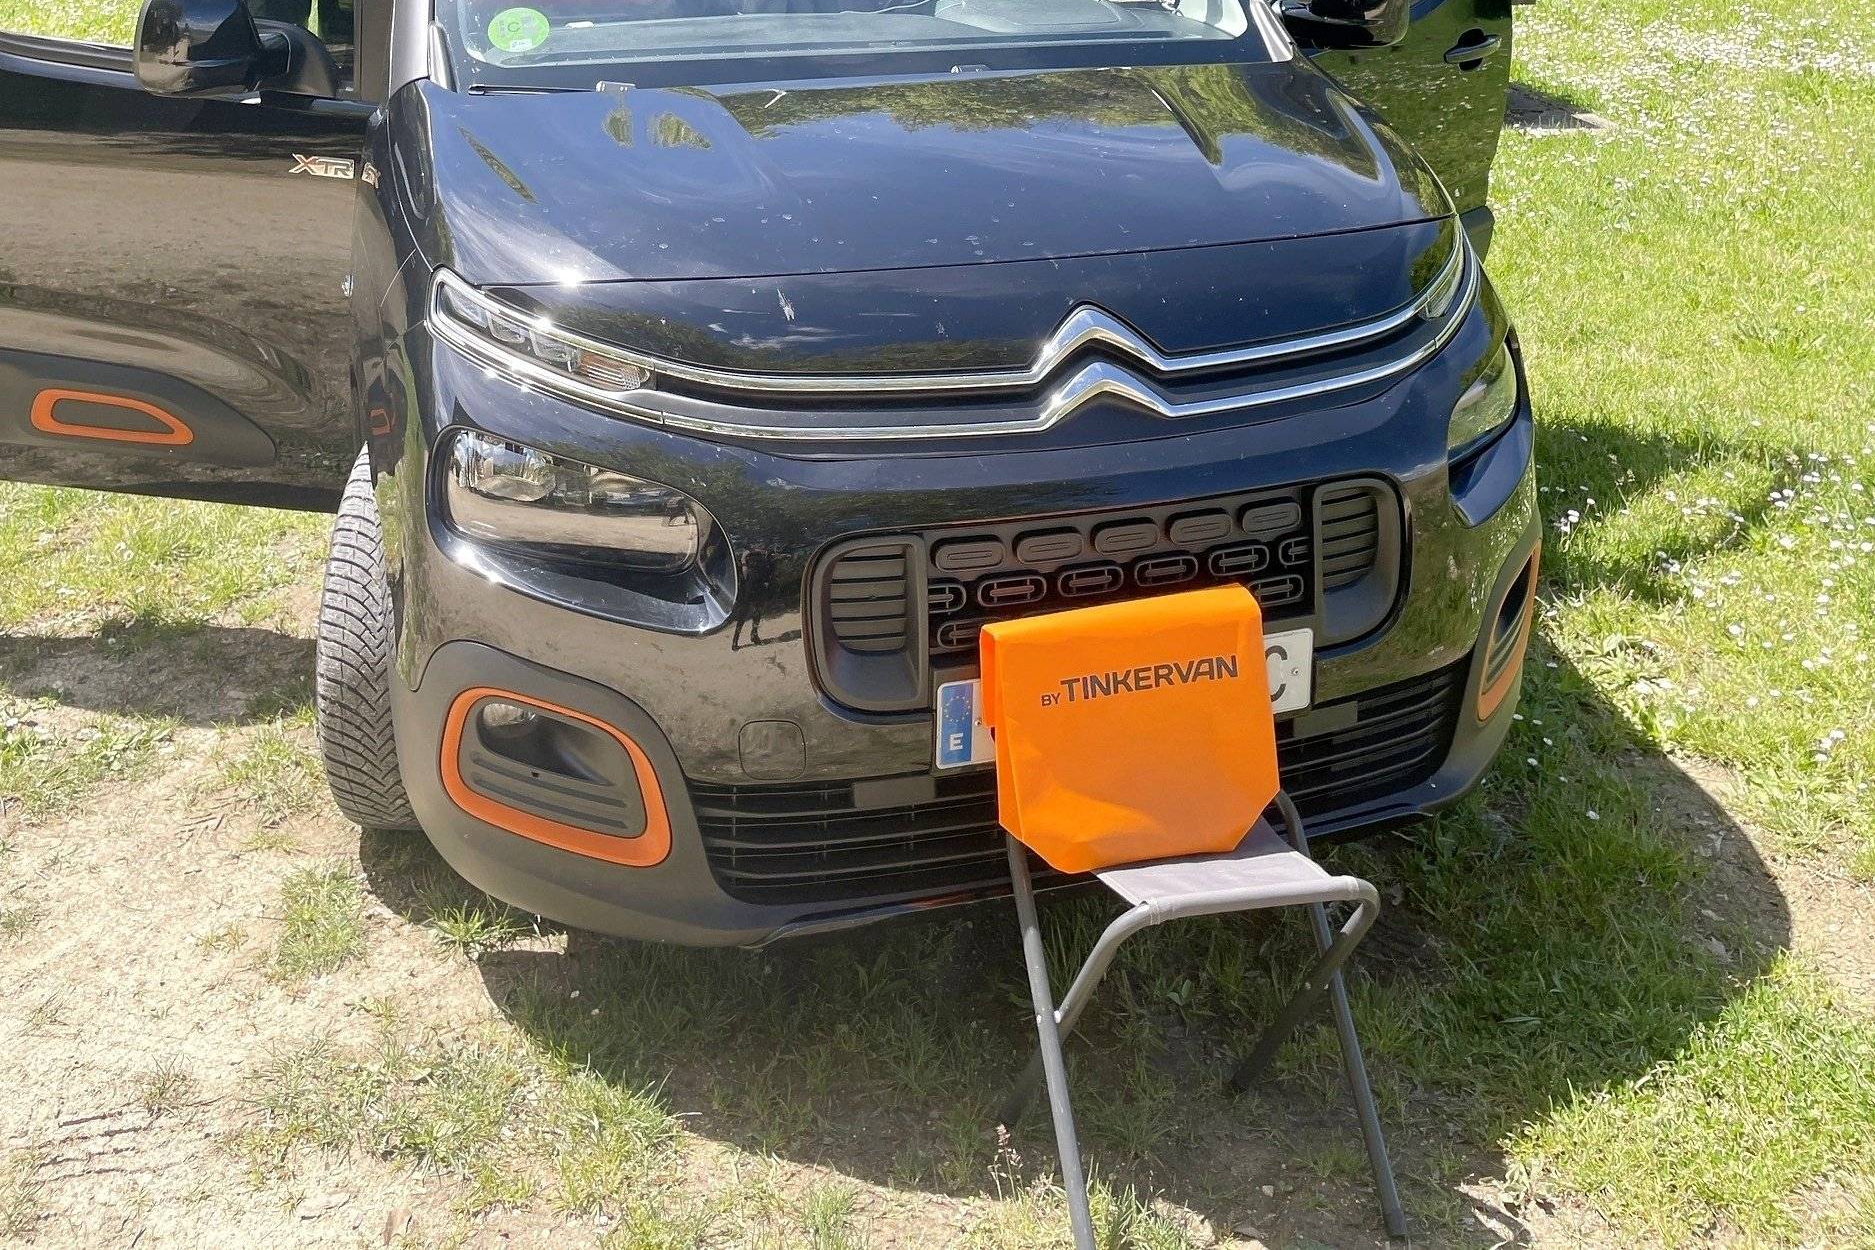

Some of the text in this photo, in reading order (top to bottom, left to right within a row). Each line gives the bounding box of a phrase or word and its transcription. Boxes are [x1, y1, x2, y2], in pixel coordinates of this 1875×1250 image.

[288, 153, 354, 179] XTR
[1041, 654, 1239, 707] BY TINKERVAN
[949, 732, 964, 751] E
